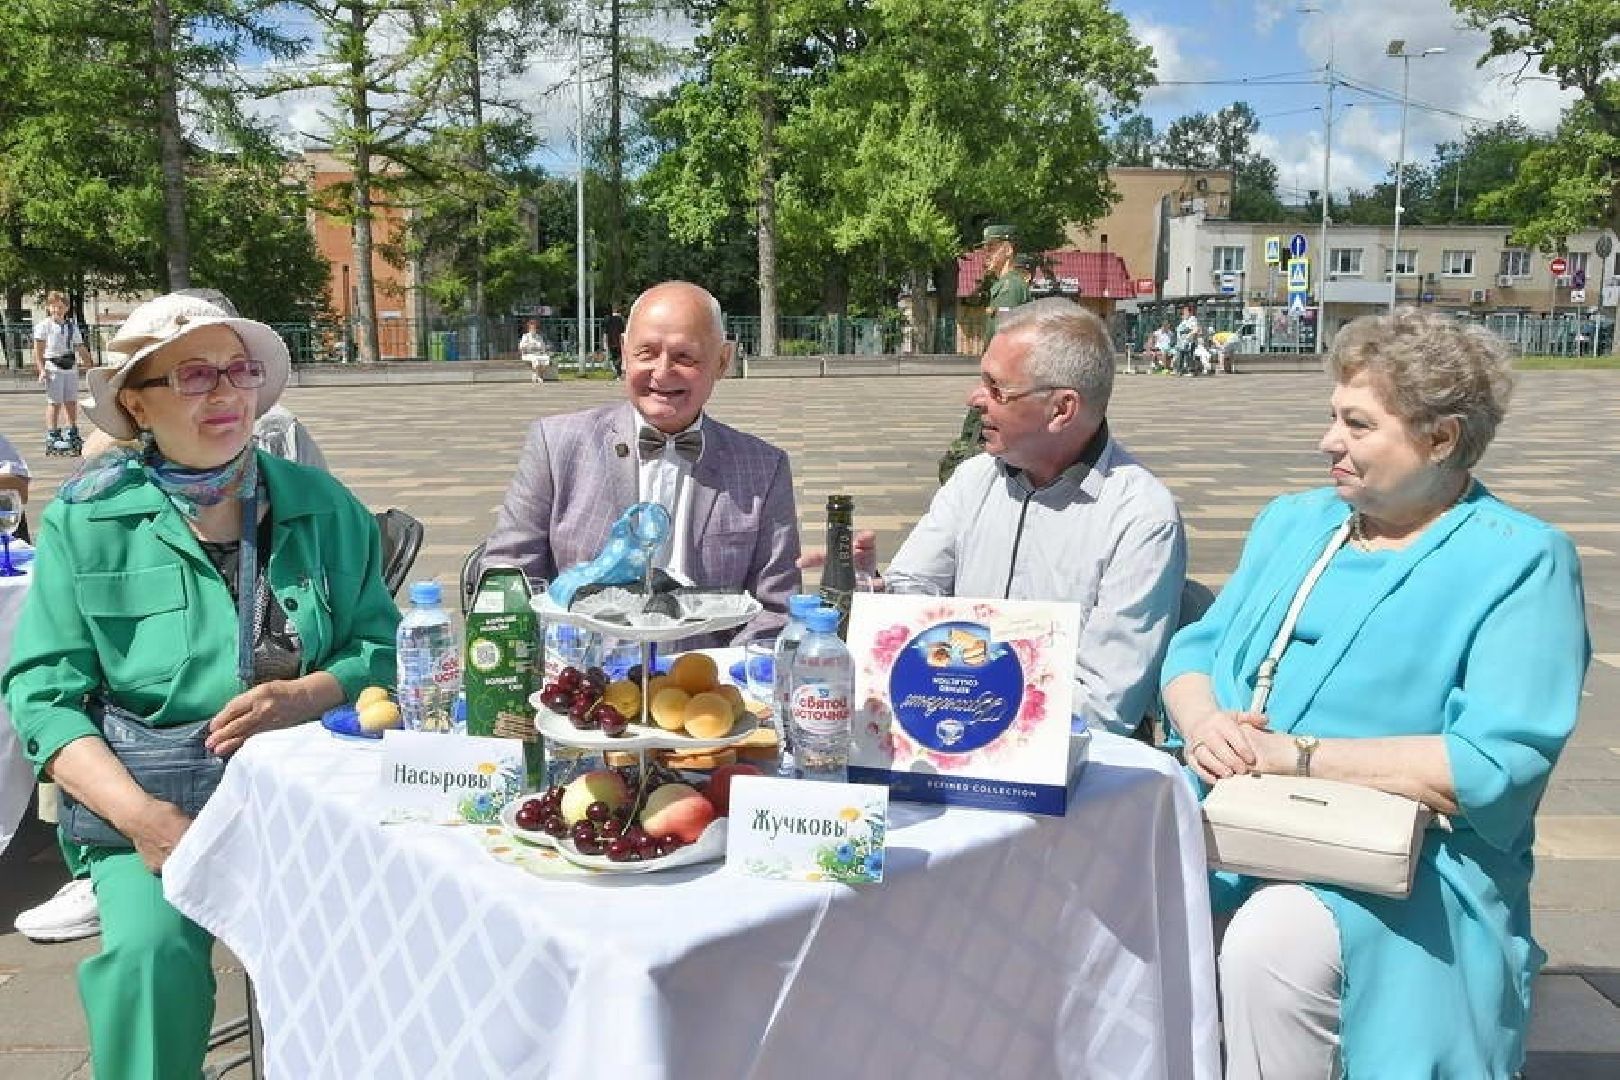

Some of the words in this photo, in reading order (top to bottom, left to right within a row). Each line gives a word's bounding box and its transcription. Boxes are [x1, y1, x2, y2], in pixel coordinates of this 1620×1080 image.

[394, 762, 492, 793] Насыровы
[927, 780, 970, 792] REFINED
[972, 784, 1037, 798] COLLECTION
[751, 809, 848, 841] Жучковы
